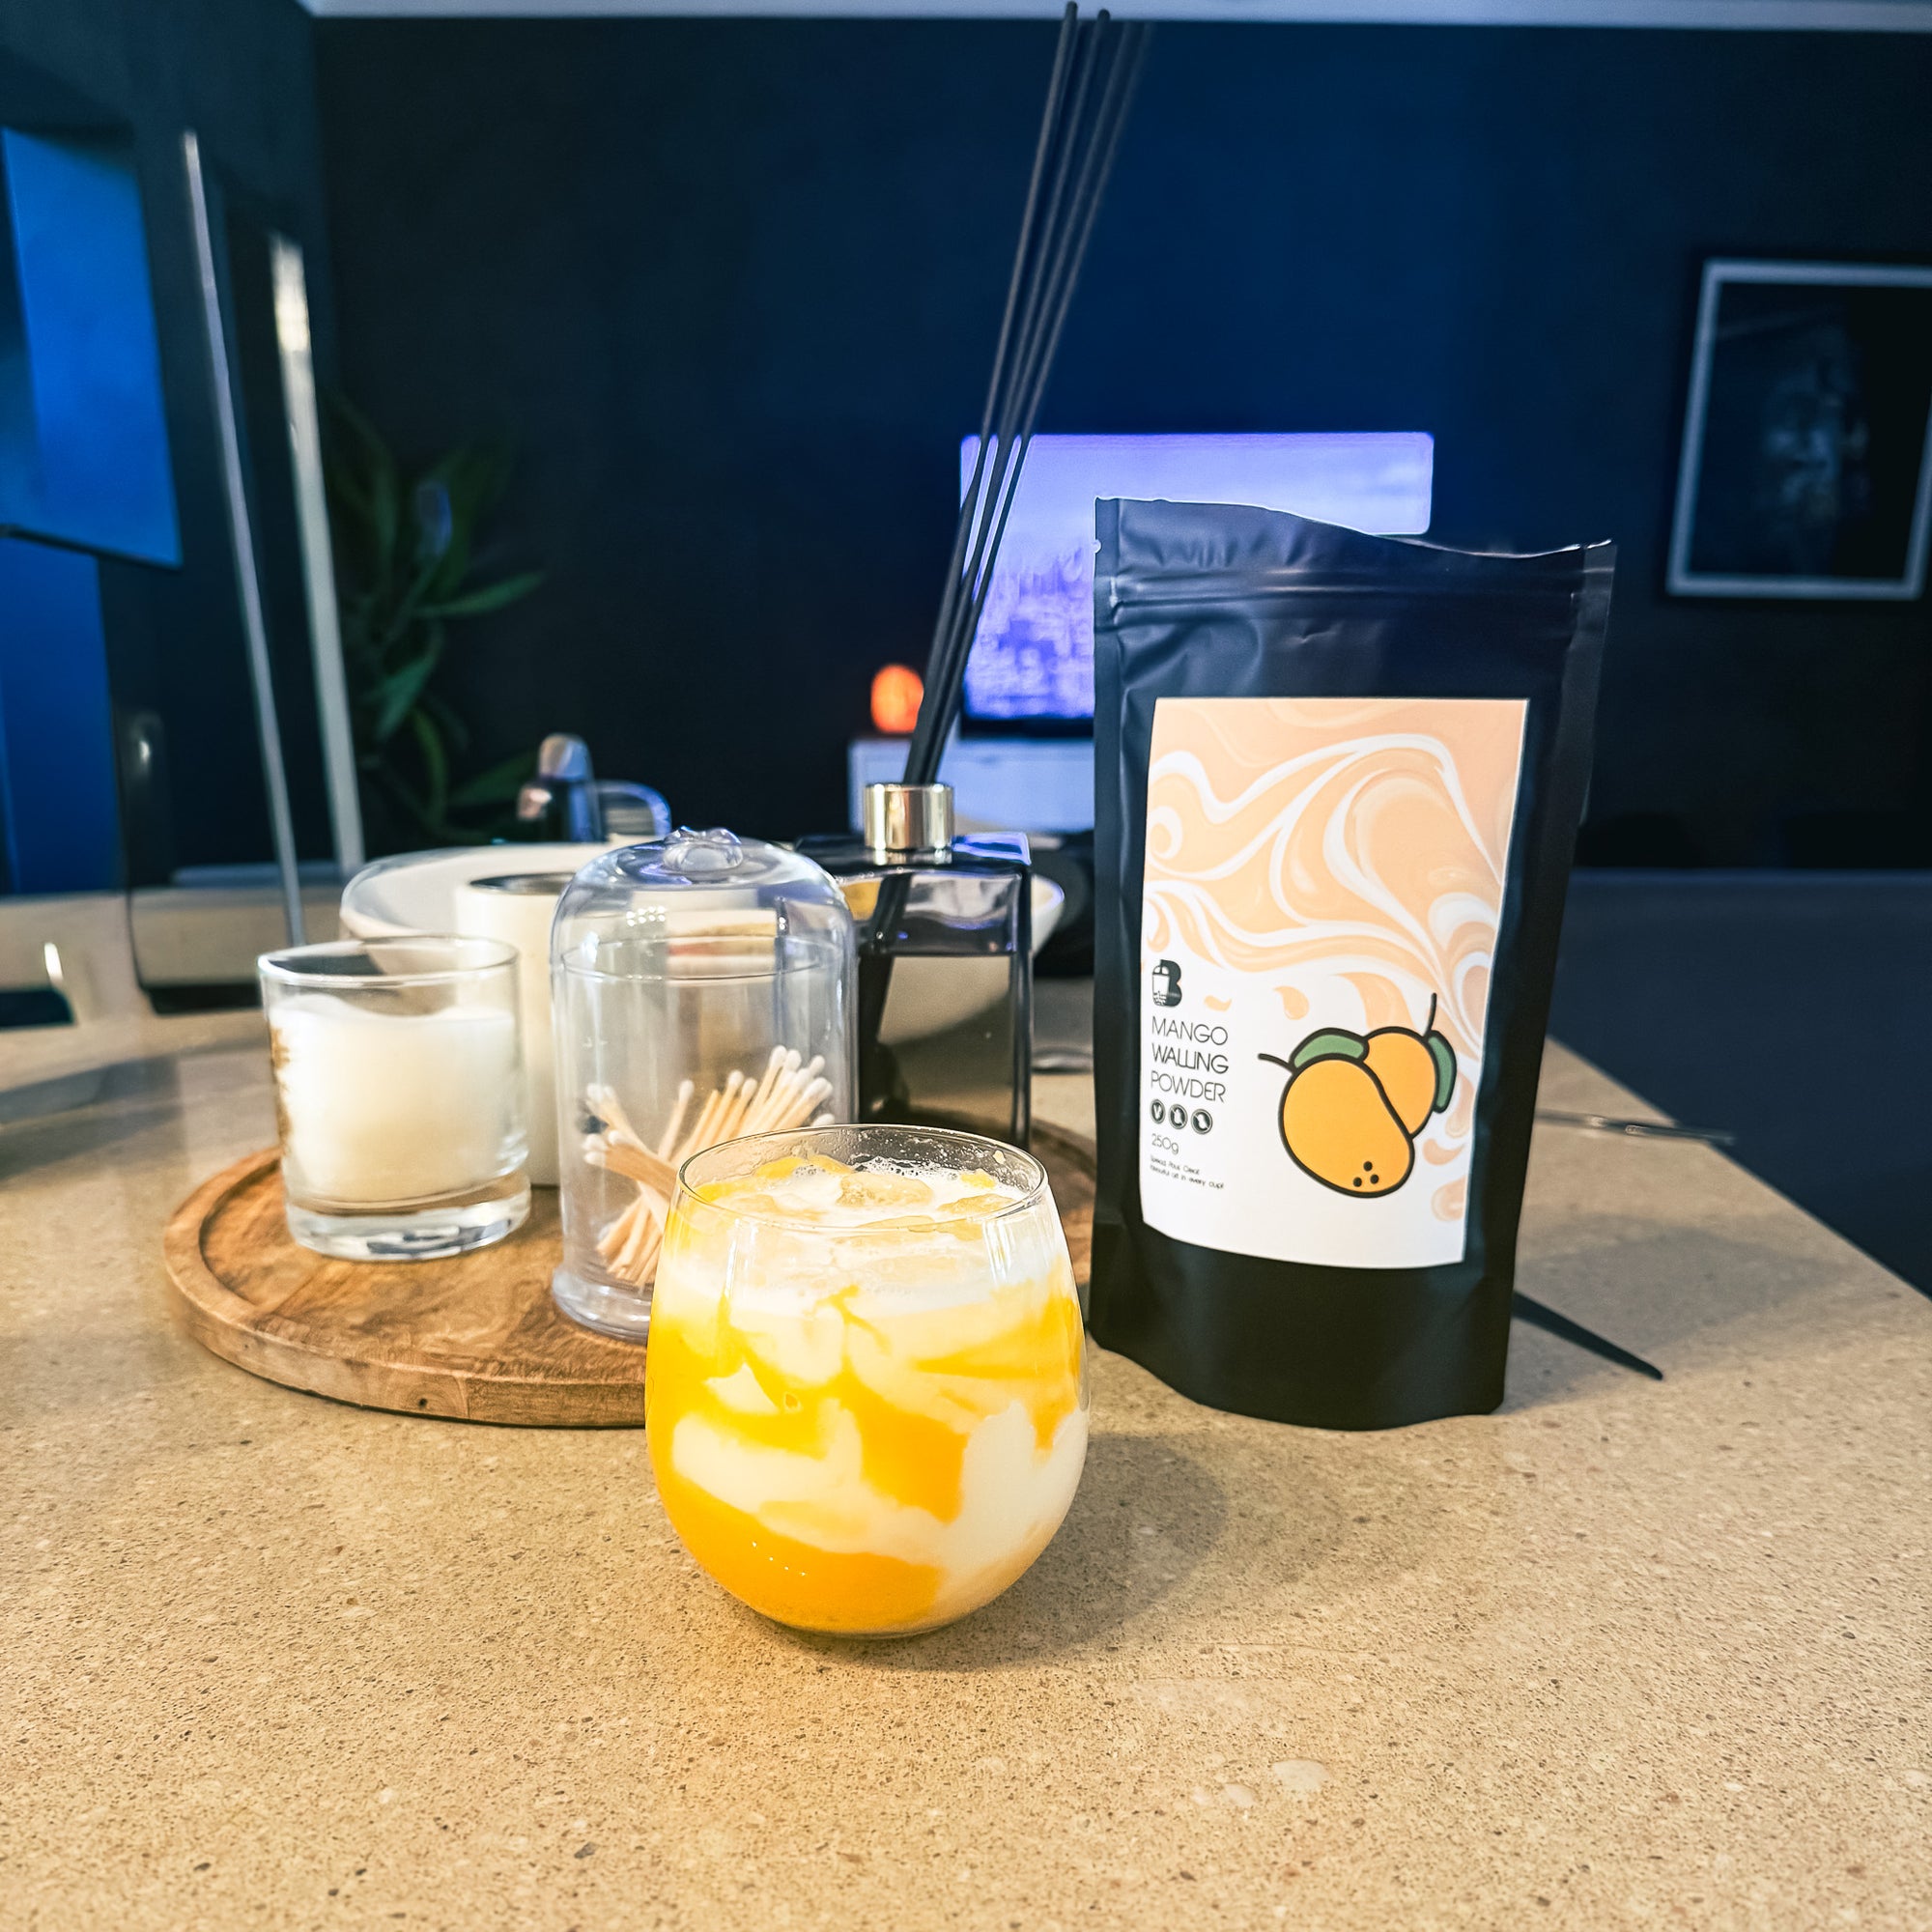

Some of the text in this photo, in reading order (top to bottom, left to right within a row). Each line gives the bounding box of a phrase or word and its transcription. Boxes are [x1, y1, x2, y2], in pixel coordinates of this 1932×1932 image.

[1152, 1015, 1228, 1045] MANGO
[1151, 1043, 1229, 1074] WALLING
[1151, 1070, 1226, 1103] POWDER
[1151, 1133, 1179, 1154] 250g
